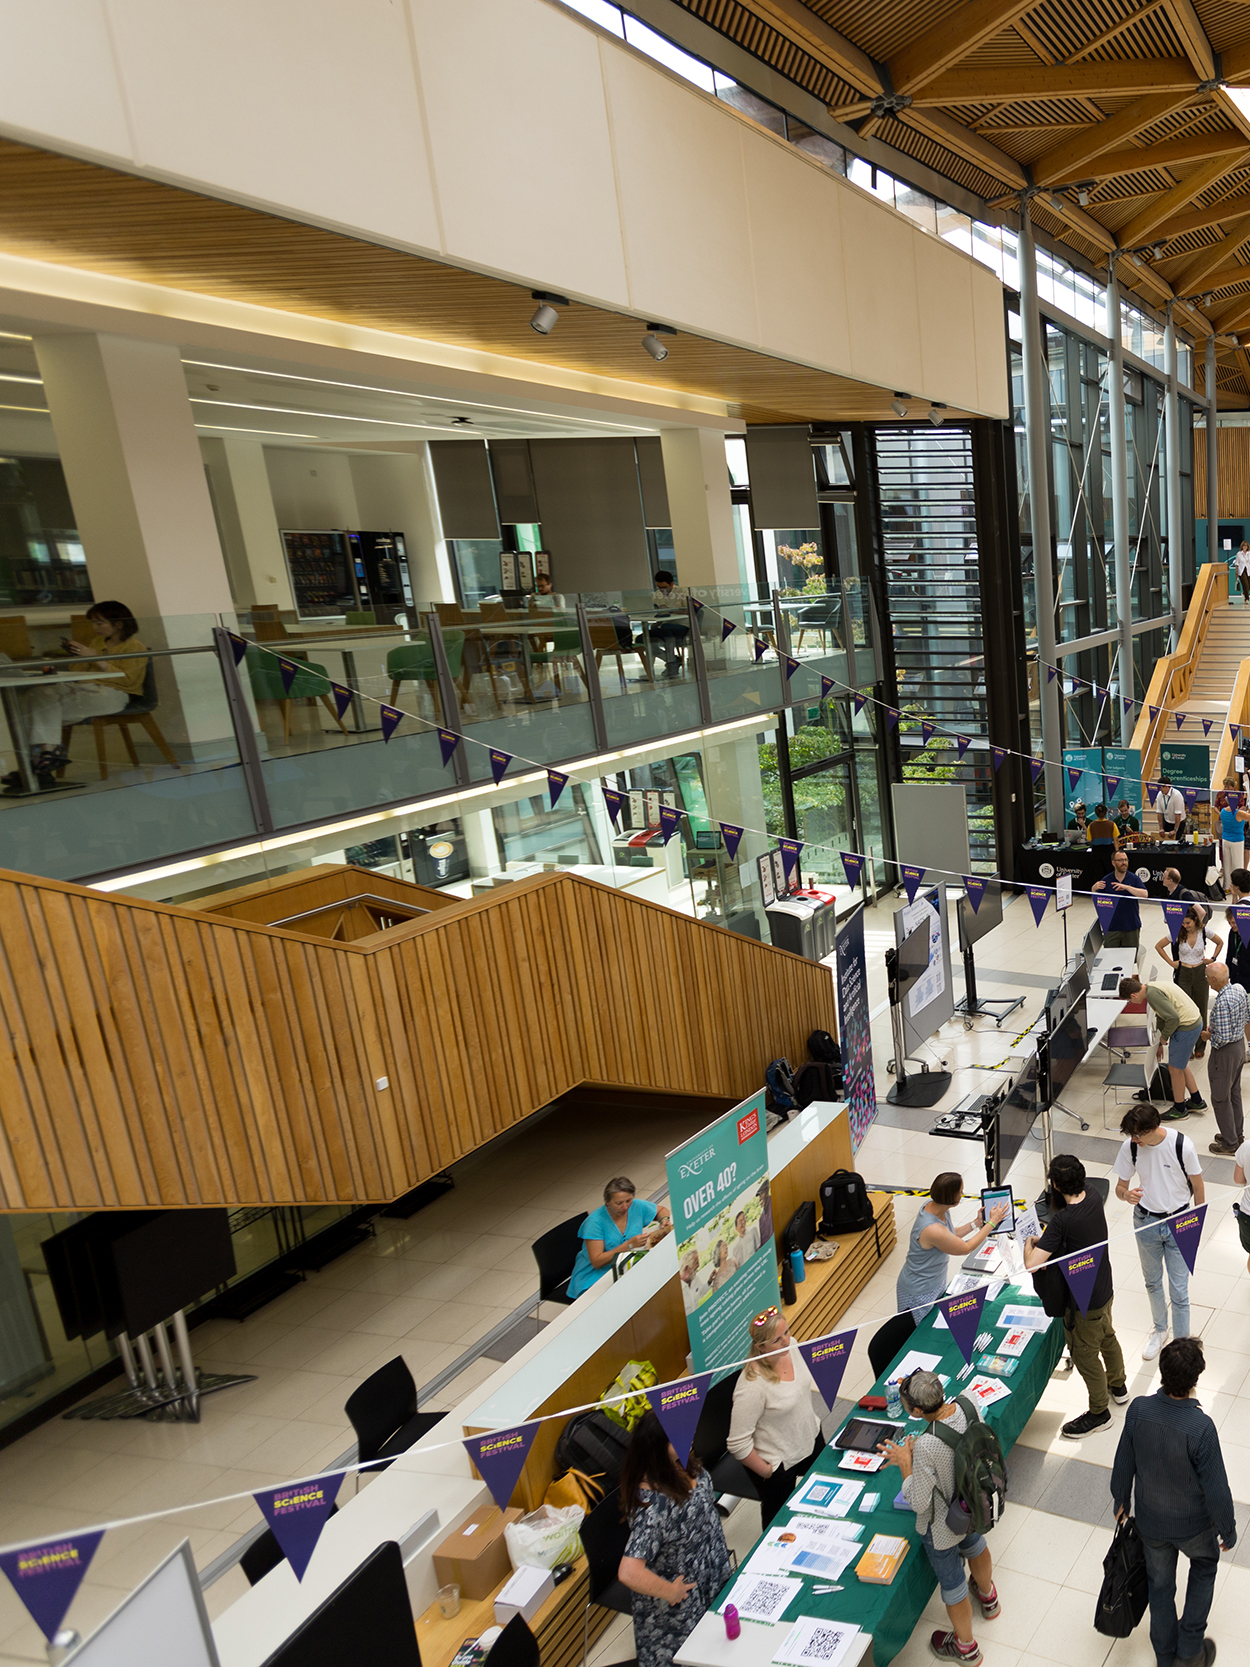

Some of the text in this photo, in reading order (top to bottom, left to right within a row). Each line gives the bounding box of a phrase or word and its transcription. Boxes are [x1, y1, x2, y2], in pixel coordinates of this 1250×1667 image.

[1056, 866, 1083, 875] University
[678, 1148, 716, 1180] EXETER
[684, 1162, 737, 1219] OVER 40?
